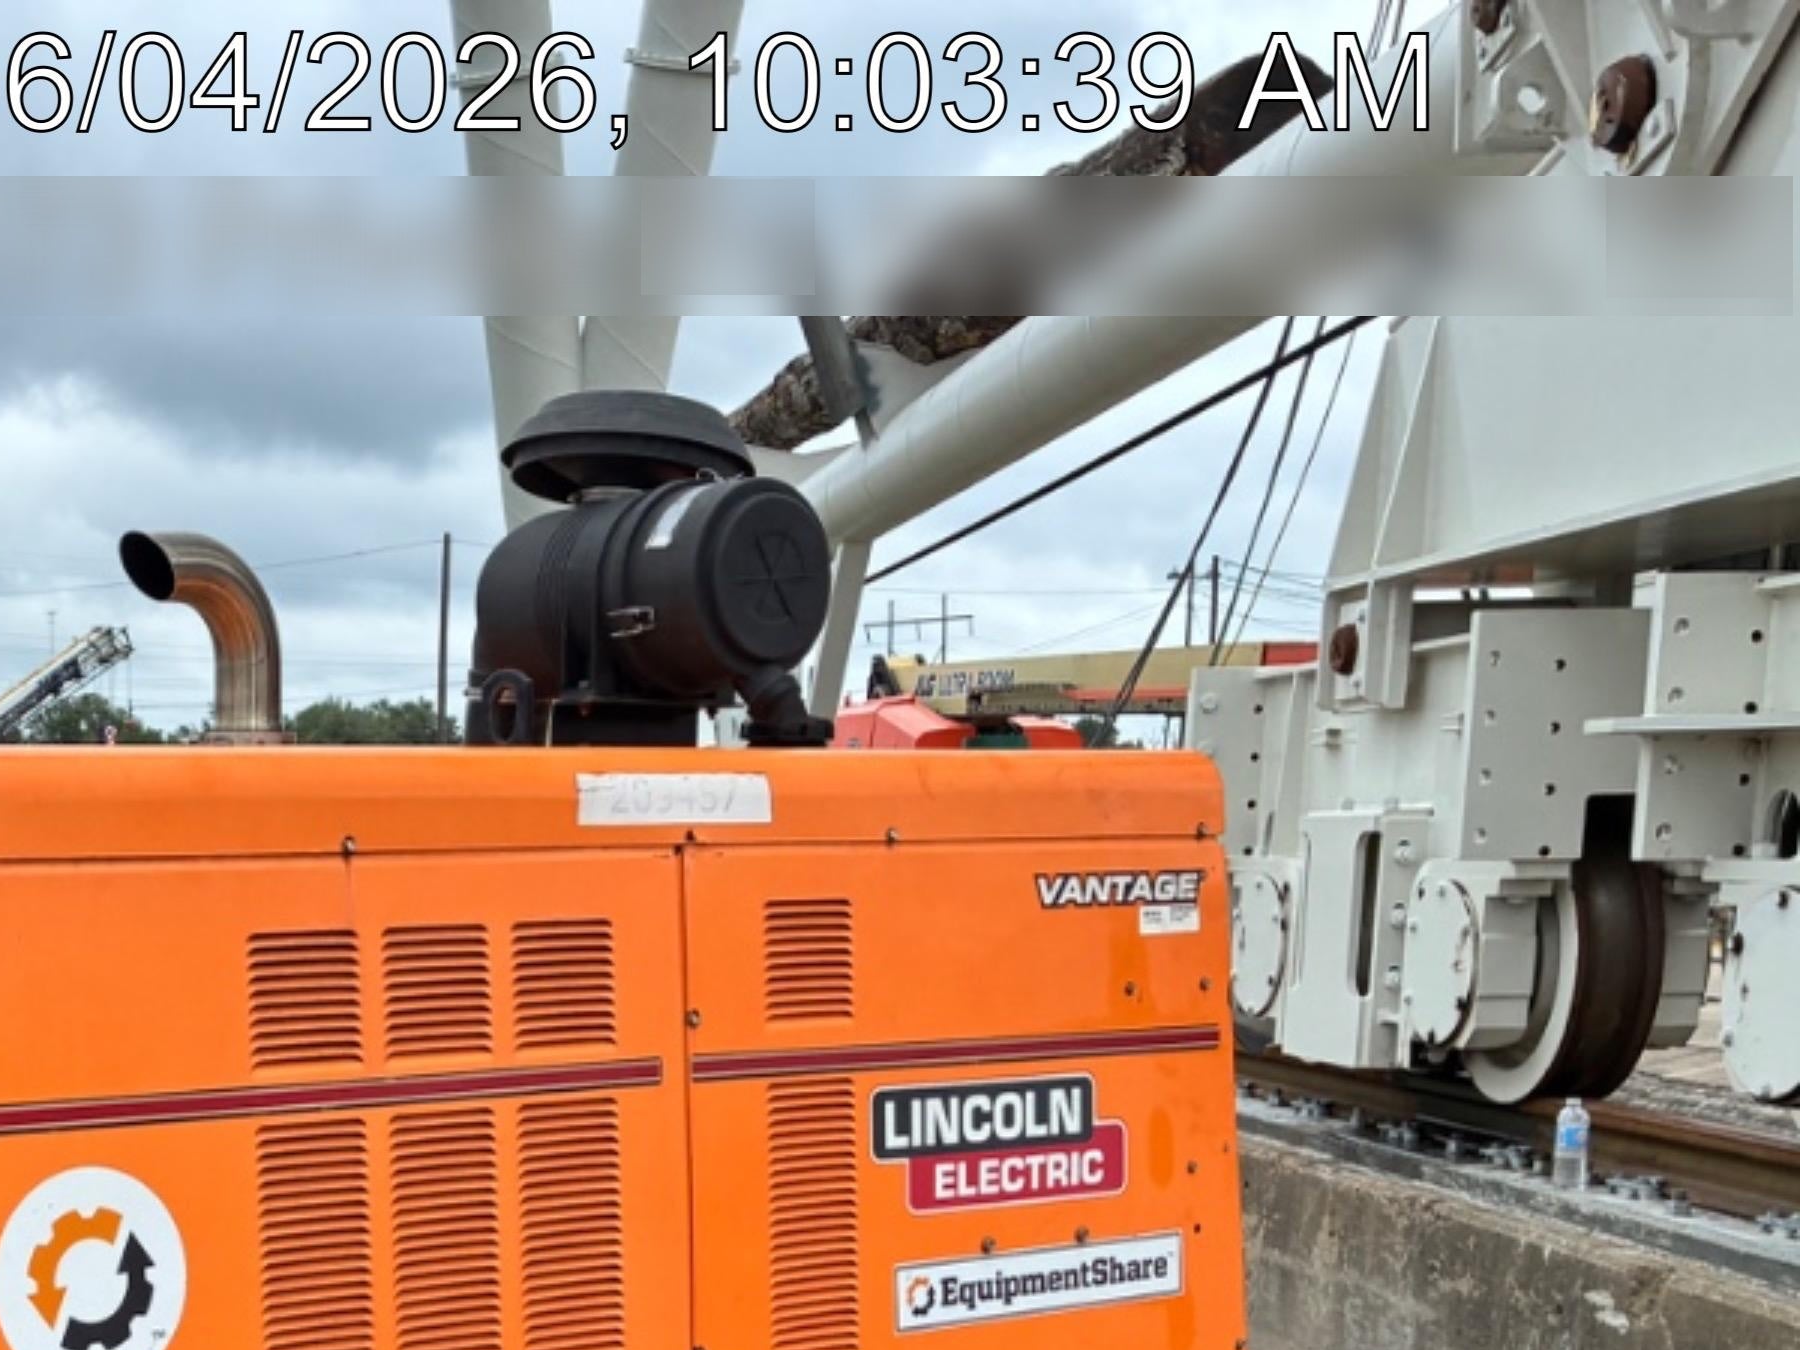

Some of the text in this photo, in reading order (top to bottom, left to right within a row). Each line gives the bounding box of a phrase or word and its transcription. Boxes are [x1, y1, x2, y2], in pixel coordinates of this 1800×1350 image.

[1036, 871, 1200, 906] VANTAGE
[883, 1085, 1083, 1151] LINCOLN
[933, 1150, 1105, 1201] ELECTRIC
[940, 1254, 1169, 1310] EquipmentShare
